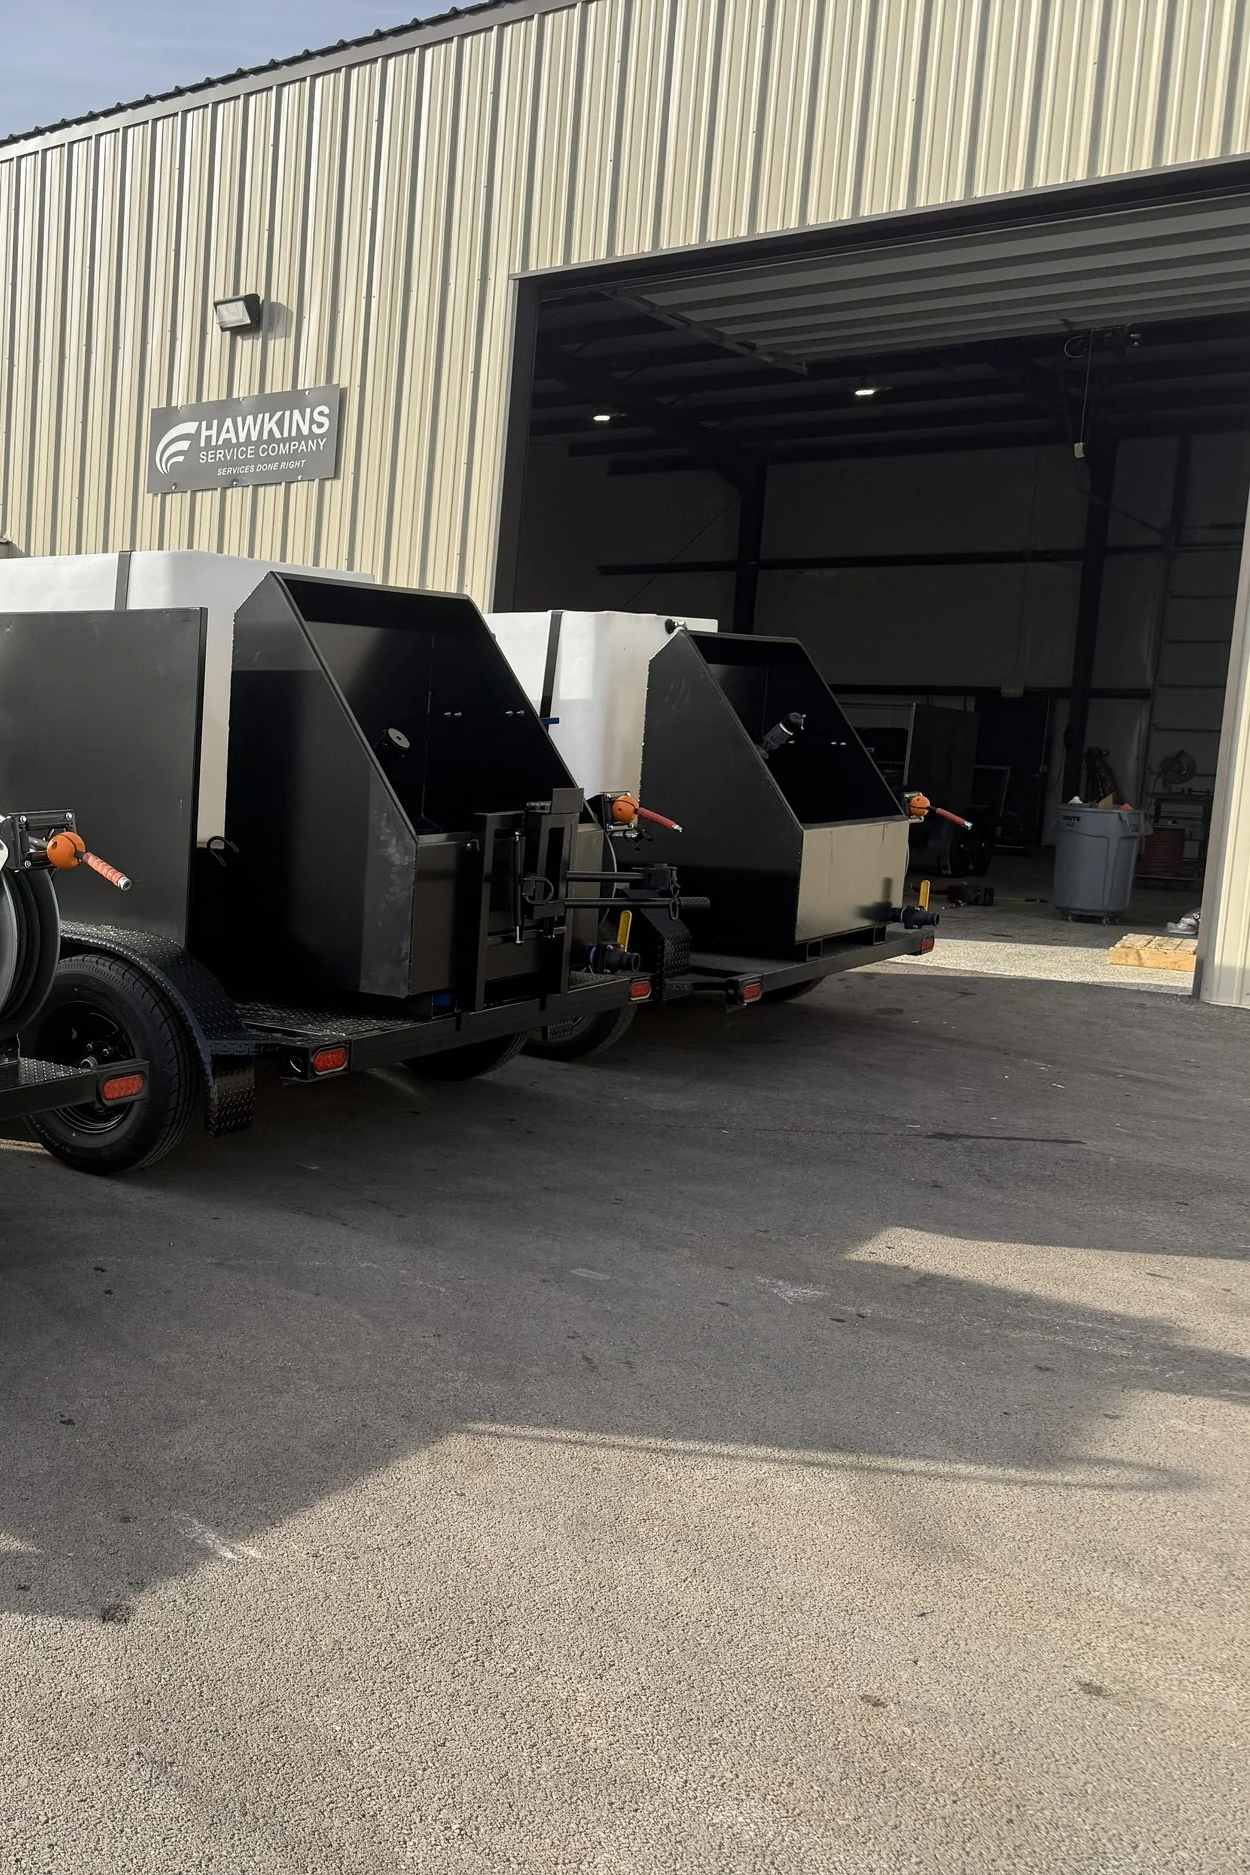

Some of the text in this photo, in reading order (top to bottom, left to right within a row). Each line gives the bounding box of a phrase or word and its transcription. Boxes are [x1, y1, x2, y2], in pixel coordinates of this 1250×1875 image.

[199, 405, 330, 448] HAWKINS
[199, 438, 327, 463] SERVICE COMPANY
[216, 459, 307, 476] SERVICES DONE RIGHT
